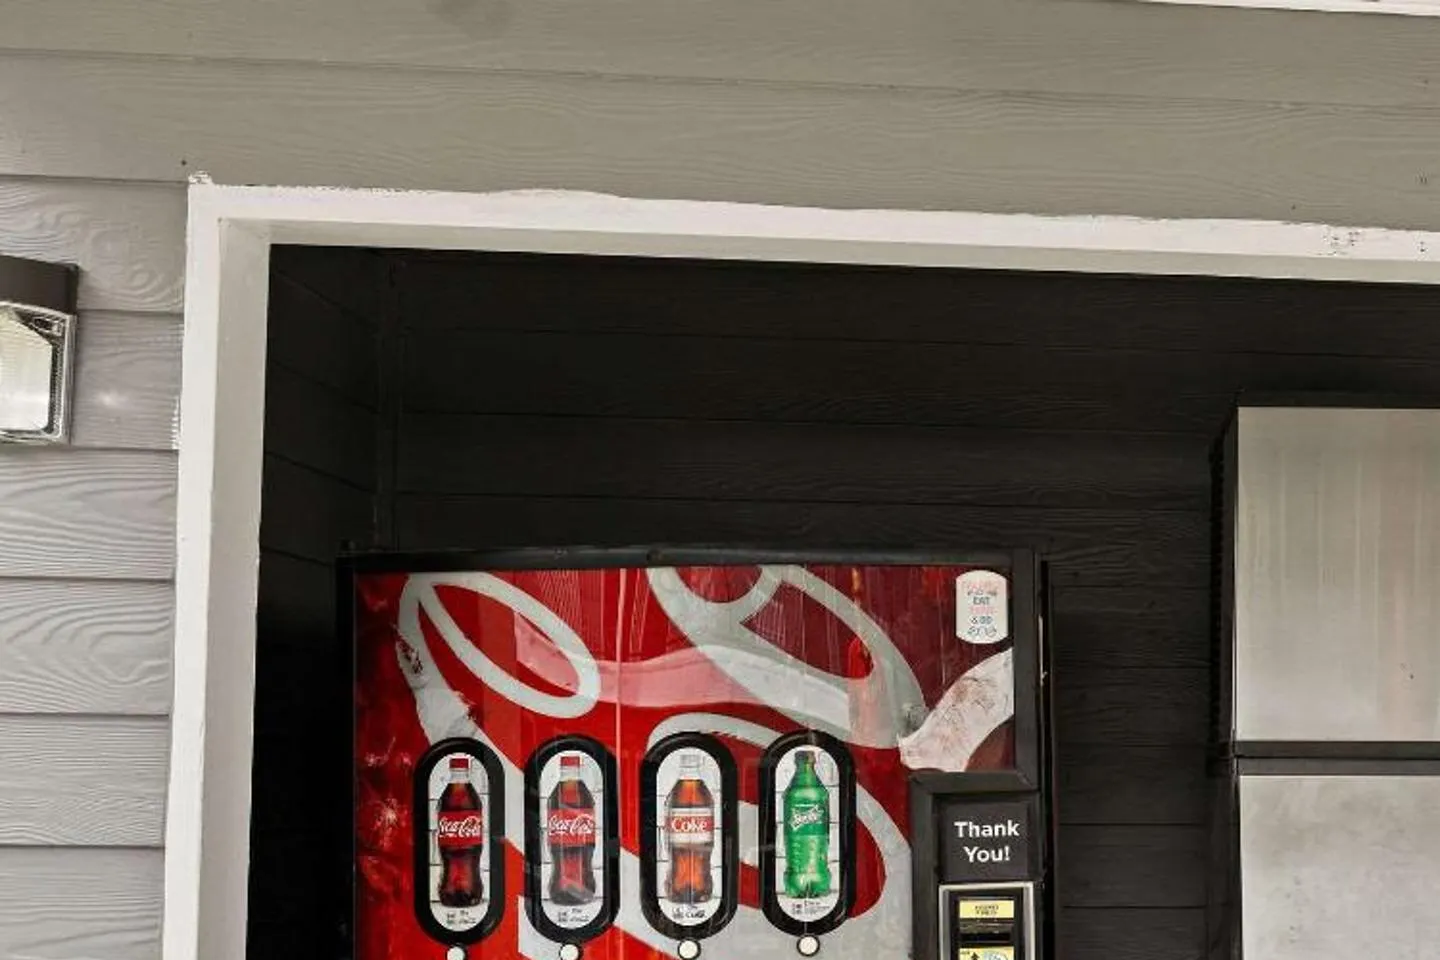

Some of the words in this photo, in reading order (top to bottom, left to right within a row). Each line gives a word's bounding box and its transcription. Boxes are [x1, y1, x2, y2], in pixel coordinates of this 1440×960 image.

[671, 817, 708, 833] Coke
[953, 820, 1020, 838] Thank
[963, 846, 1011, 863] You!
